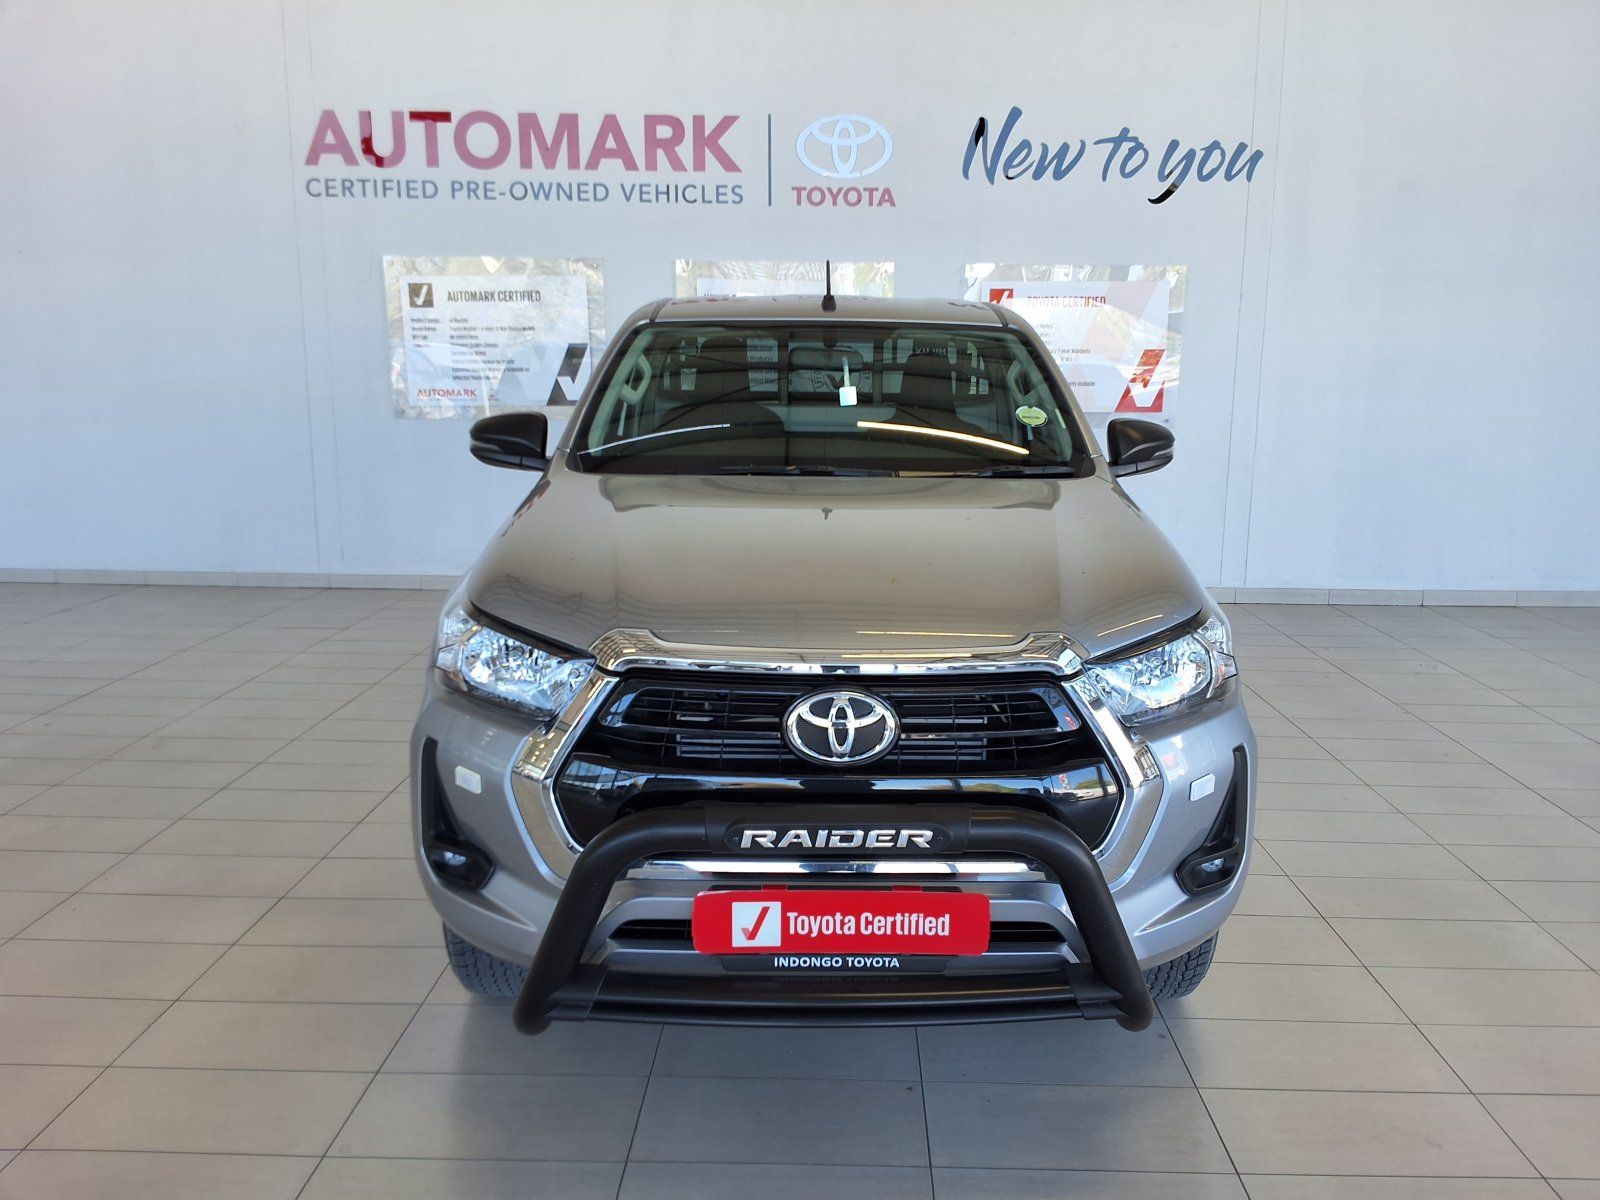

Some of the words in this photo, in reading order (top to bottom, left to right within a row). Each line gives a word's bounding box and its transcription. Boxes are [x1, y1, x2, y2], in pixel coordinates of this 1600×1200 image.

[304, 109, 743, 174] AUTOMARK
[962, 106, 1086, 186] New
[1093, 126, 1150, 182] to
[1147, 139, 1264, 205] you
[305, 178, 439, 199] CERTIFIED
[450, 181, 610, 202] PRE-OWNED
[620, 184, 744, 205] VEHICLES
[792, 187, 897, 208] TOYOTA
[447, 290, 496, 303] AUTOMARK
[498, 290, 541, 303] CERTIFIED
[1026, 295, 1060, 308] TOYOTA
[1062, 295, 1106, 308] CERTIFIED
[417, 388, 477, 399] AUTOMARK
[740, 829, 934, 848] RAIDER
[786, 911, 856, 938] Toyota
[860, 911, 950, 936] Certified
[774, 957, 843, 968] INDONGO
[846, 957, 900, 968] TOYOTA
